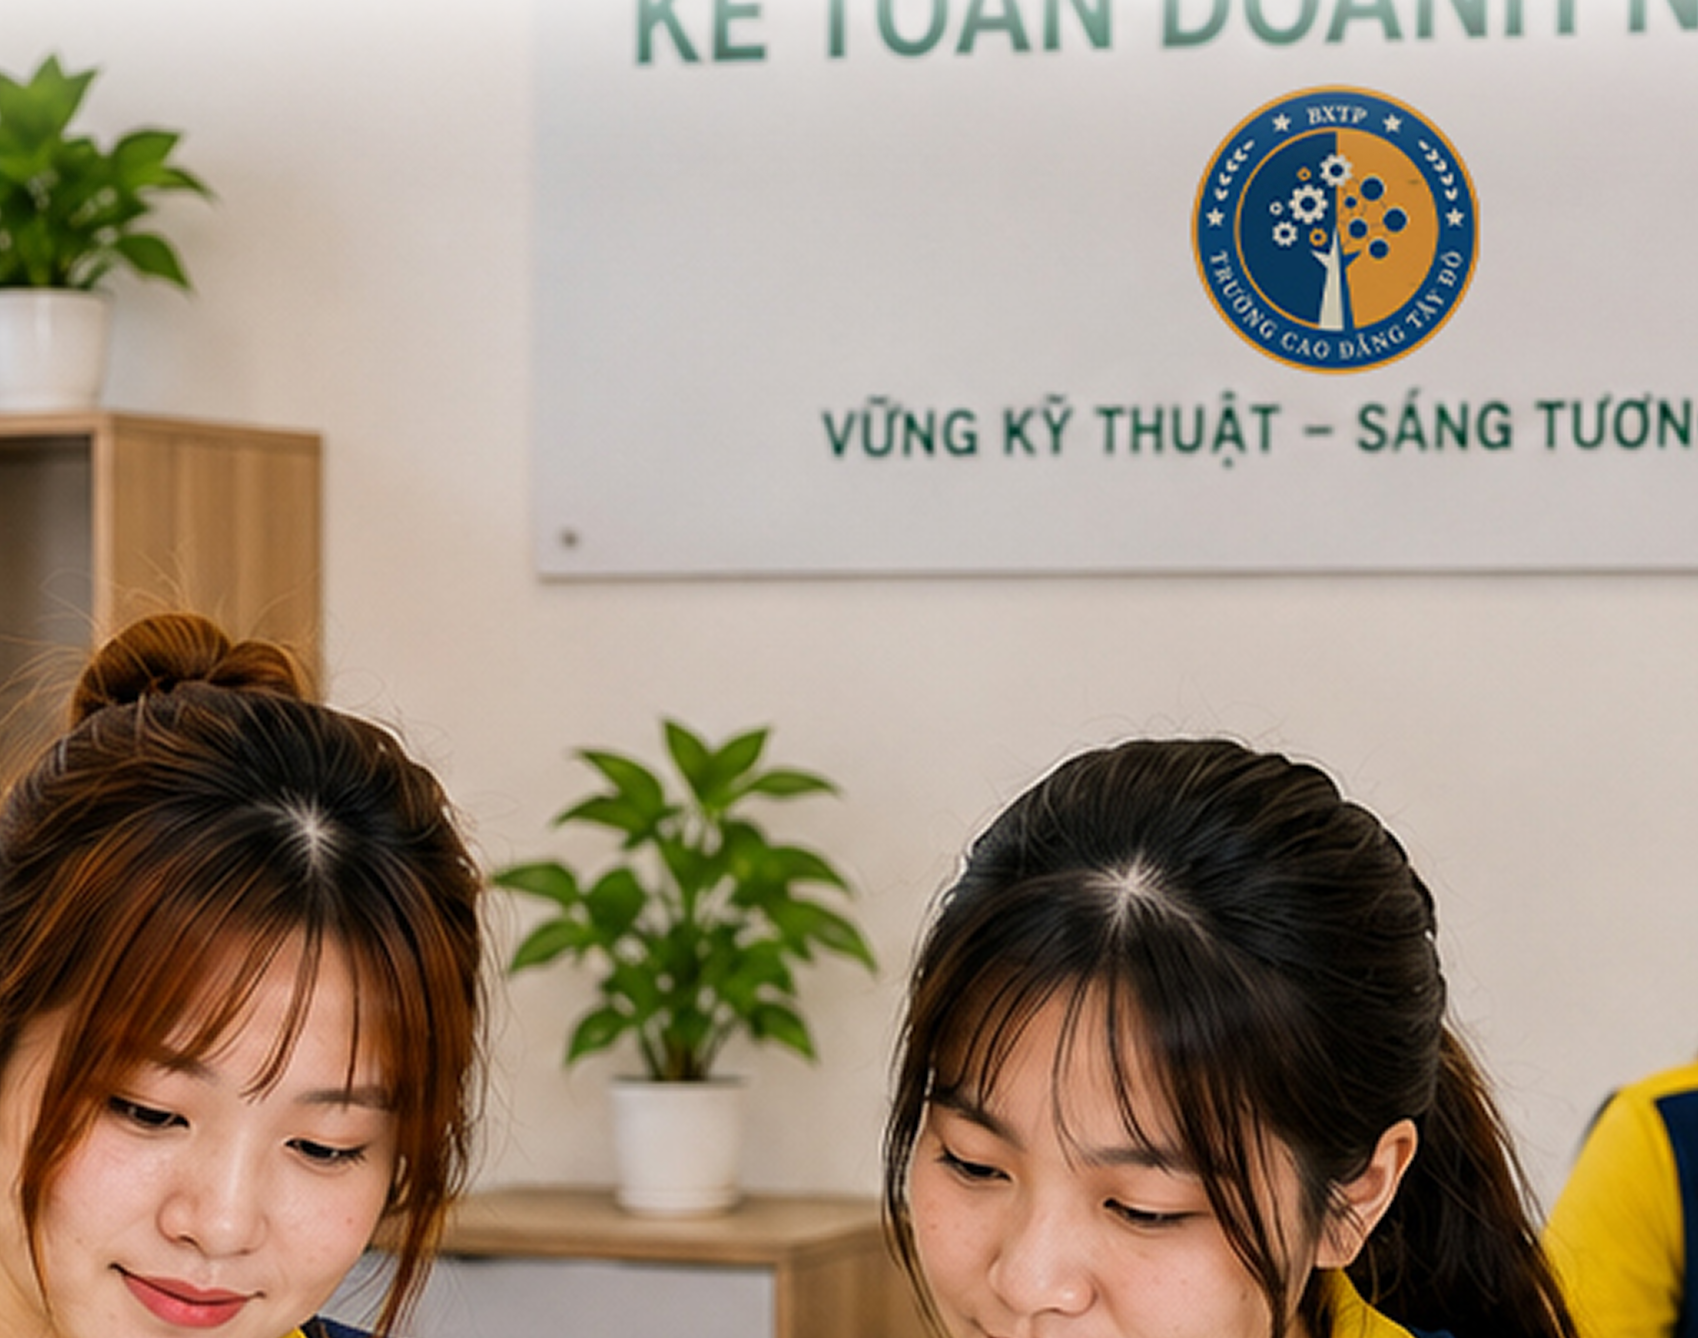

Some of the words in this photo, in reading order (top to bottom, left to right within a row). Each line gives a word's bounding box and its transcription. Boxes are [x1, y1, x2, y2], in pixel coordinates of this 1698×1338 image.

[1305, 104, 1368, 124] BXTP
[1280, 330, 1331, 360] CAO
[1094, 389, 1282, 468] THUẬT
[1357, 387, 1513, 454] SÁNG
